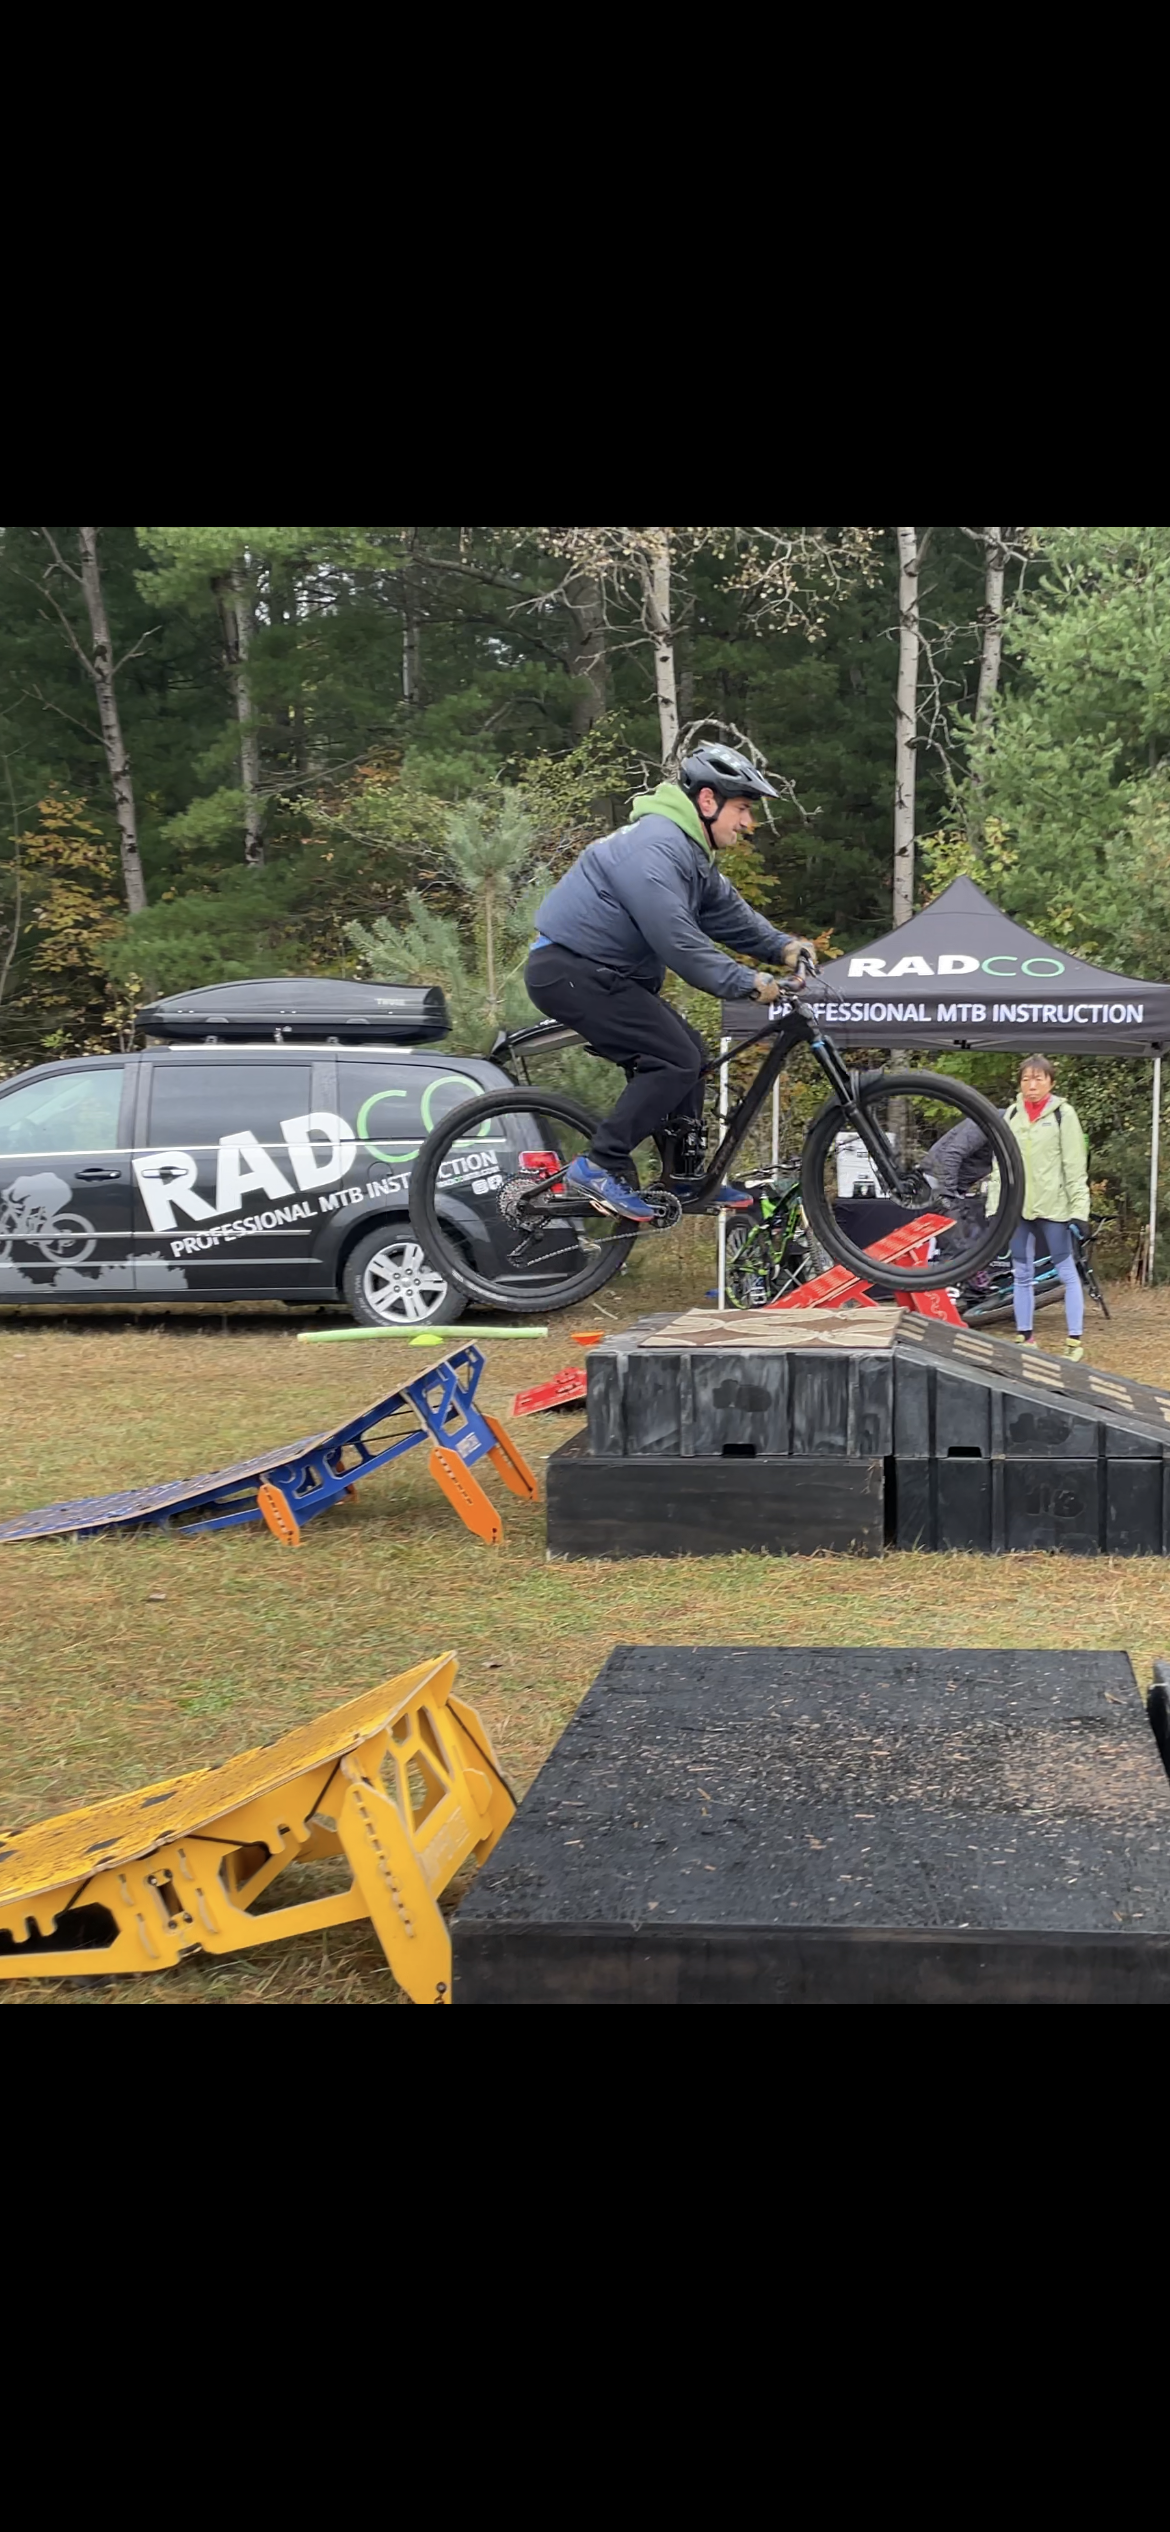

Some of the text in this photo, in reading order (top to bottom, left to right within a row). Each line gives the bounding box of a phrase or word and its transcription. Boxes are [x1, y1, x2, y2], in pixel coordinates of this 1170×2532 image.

[847, 954, 1066, 978] RADCO
[936, 1002, 988, 1023] MTB
[991, 1003, 1145, 1024] INSTRUCTION
[131, 1074, 492, 1232] RADCO
[170, 1201, 318, 1258] PROFESSIONAL
[319, 1188, 364, 1213] MTB
[367, 1149, 499, 1199] INSTCTION
